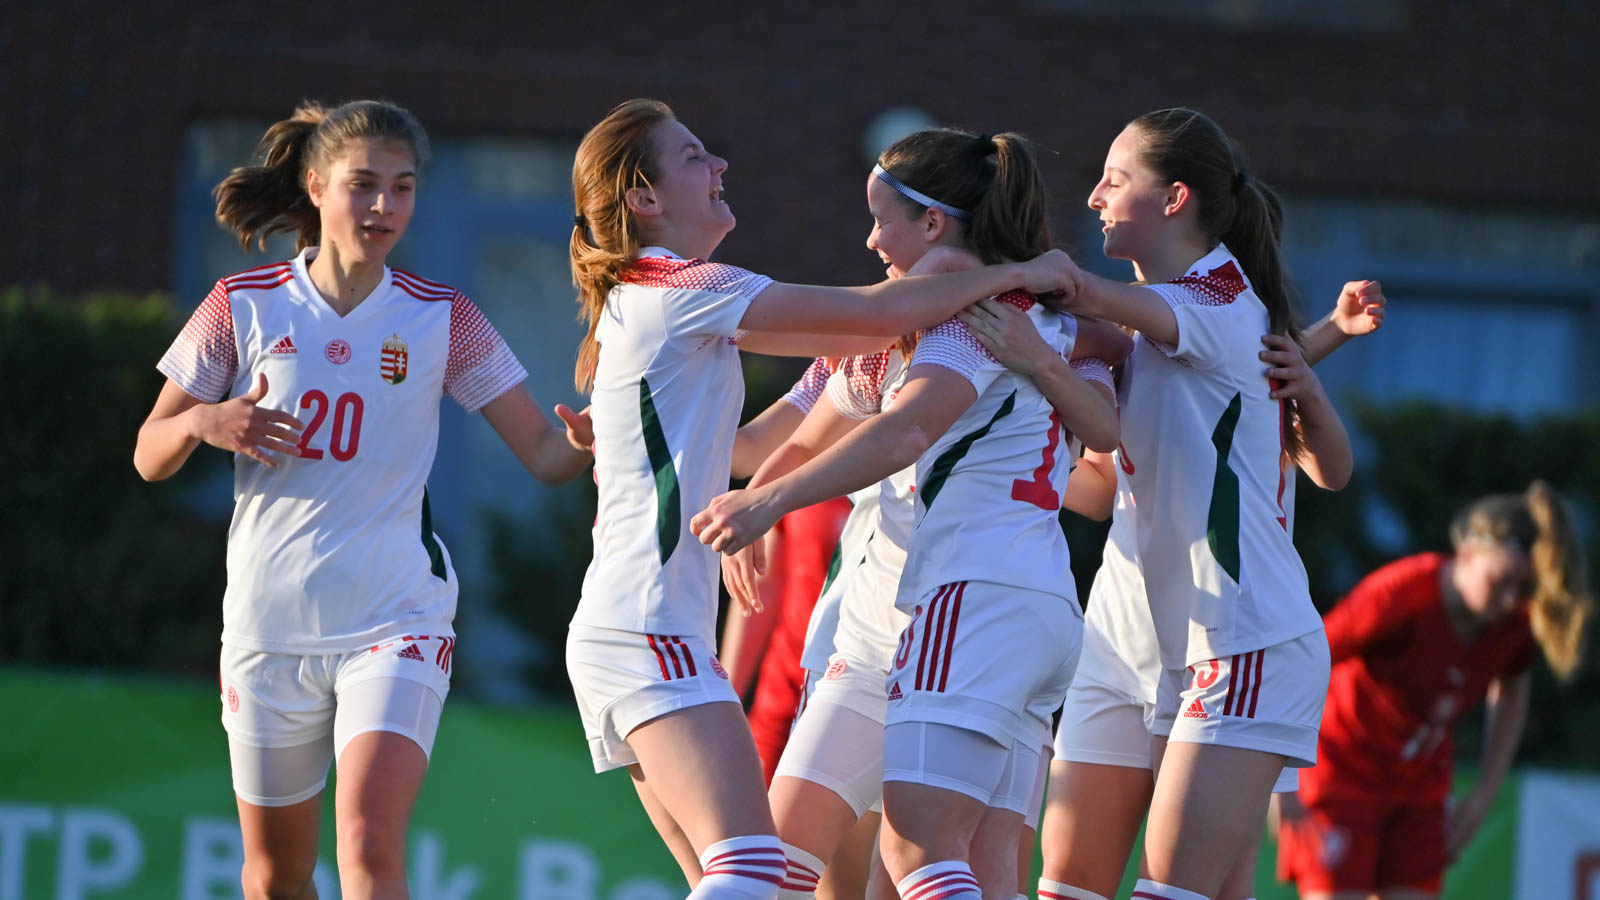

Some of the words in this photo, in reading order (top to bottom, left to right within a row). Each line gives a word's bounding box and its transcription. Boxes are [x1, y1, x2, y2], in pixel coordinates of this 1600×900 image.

[297, 389, 364, 462] 20
[397, 652, 424, 662] adidas
[1184, 711, 1208, 719] adidas
